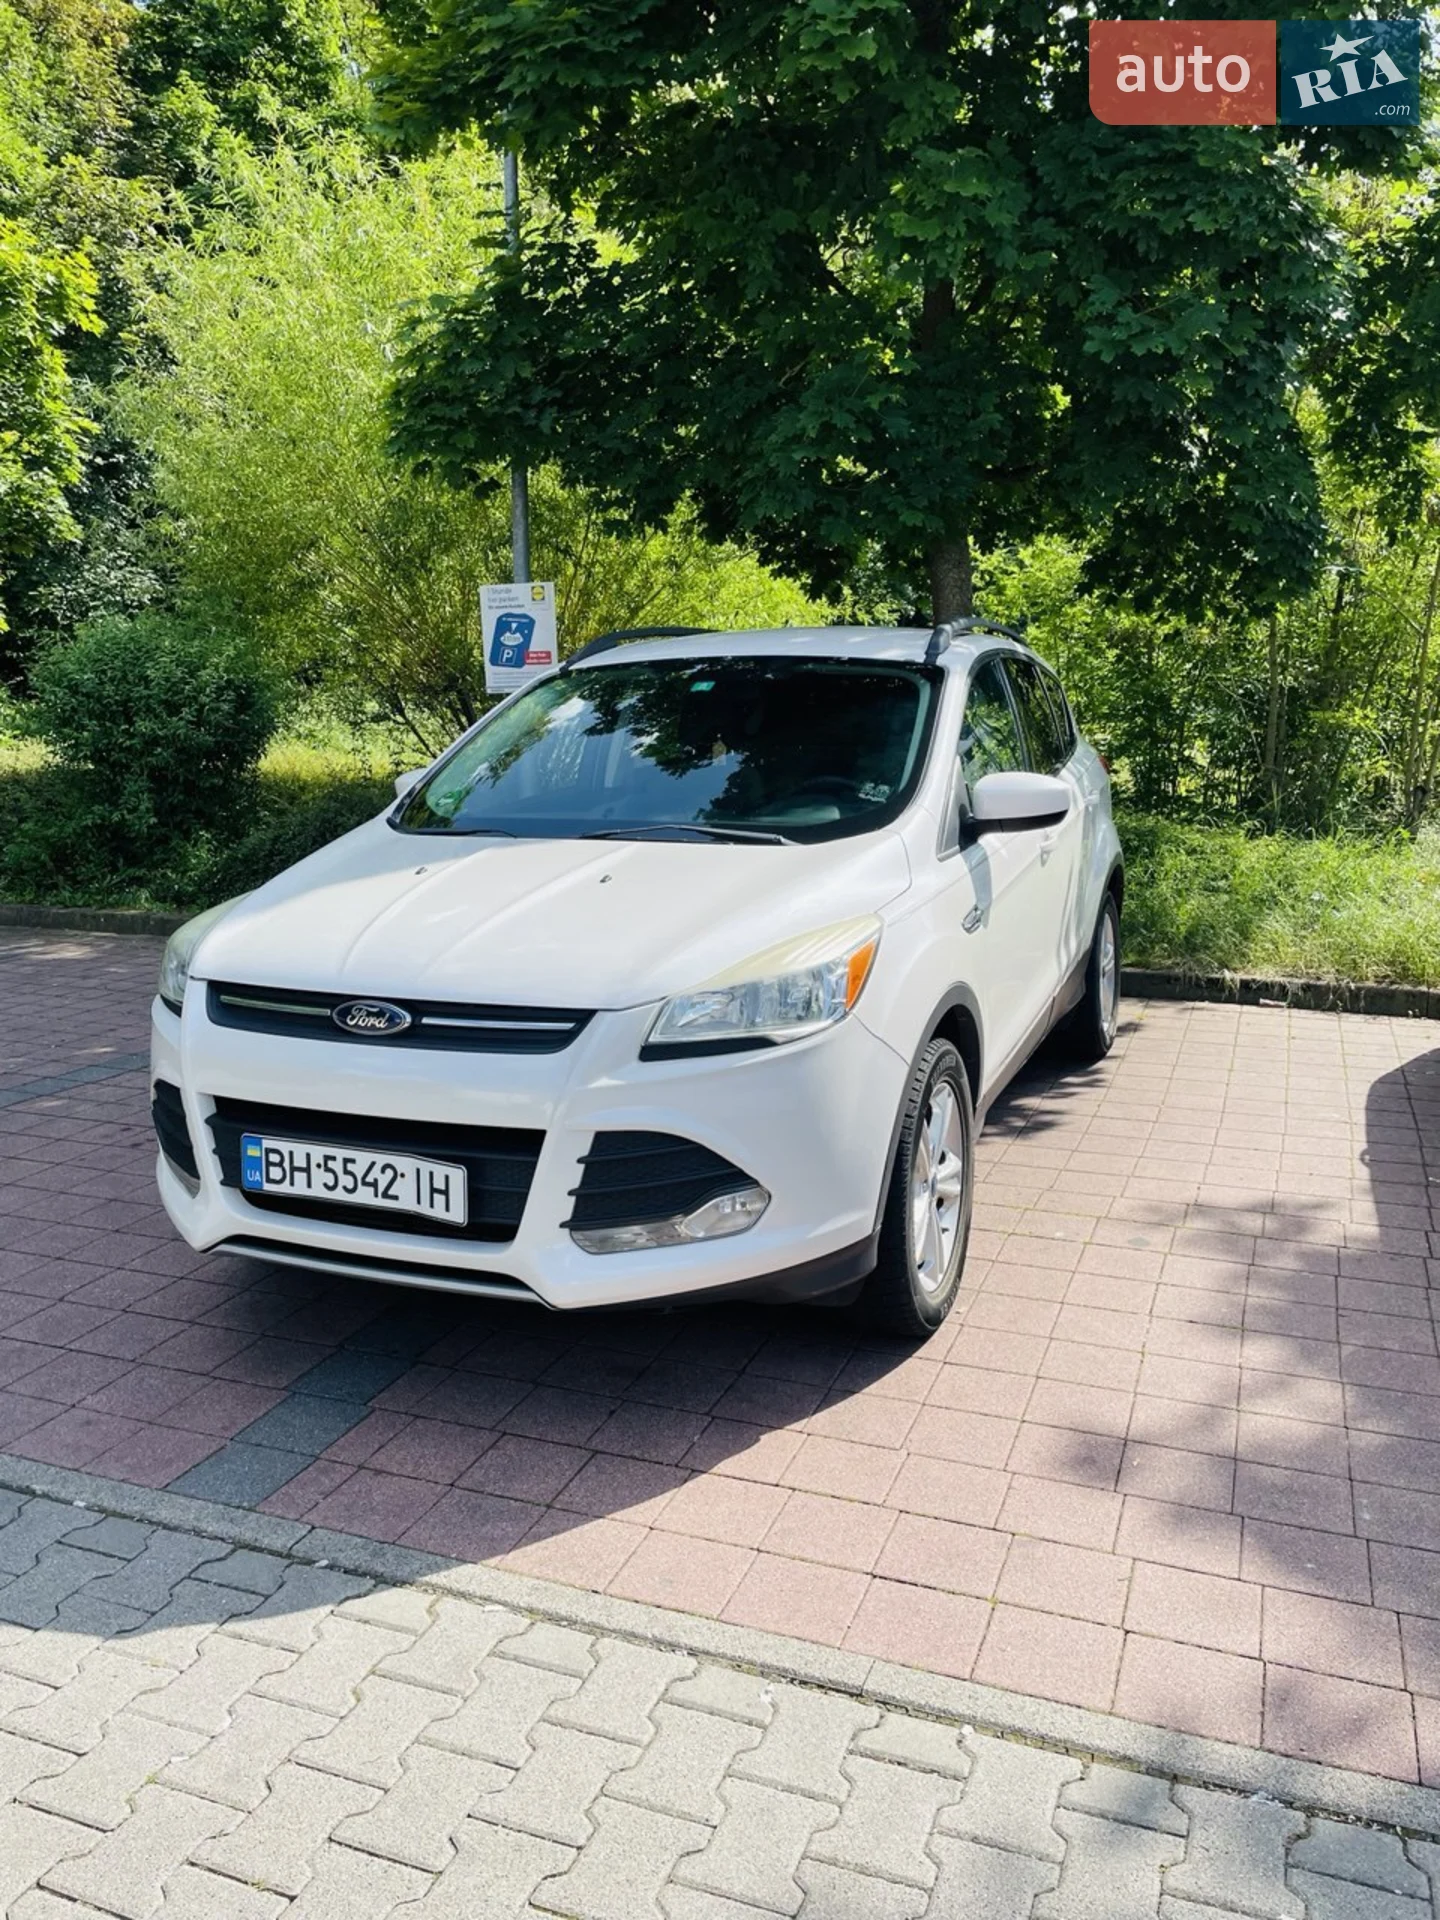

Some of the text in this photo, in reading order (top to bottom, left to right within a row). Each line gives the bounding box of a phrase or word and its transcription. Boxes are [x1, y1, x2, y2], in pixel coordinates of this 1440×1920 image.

[502, 649, 512, 662] P
[346, 1004, 389, 1028] Ford
[247, 1169, 262, 1183] UA
[322, 1154, 399, 1201] 5542
